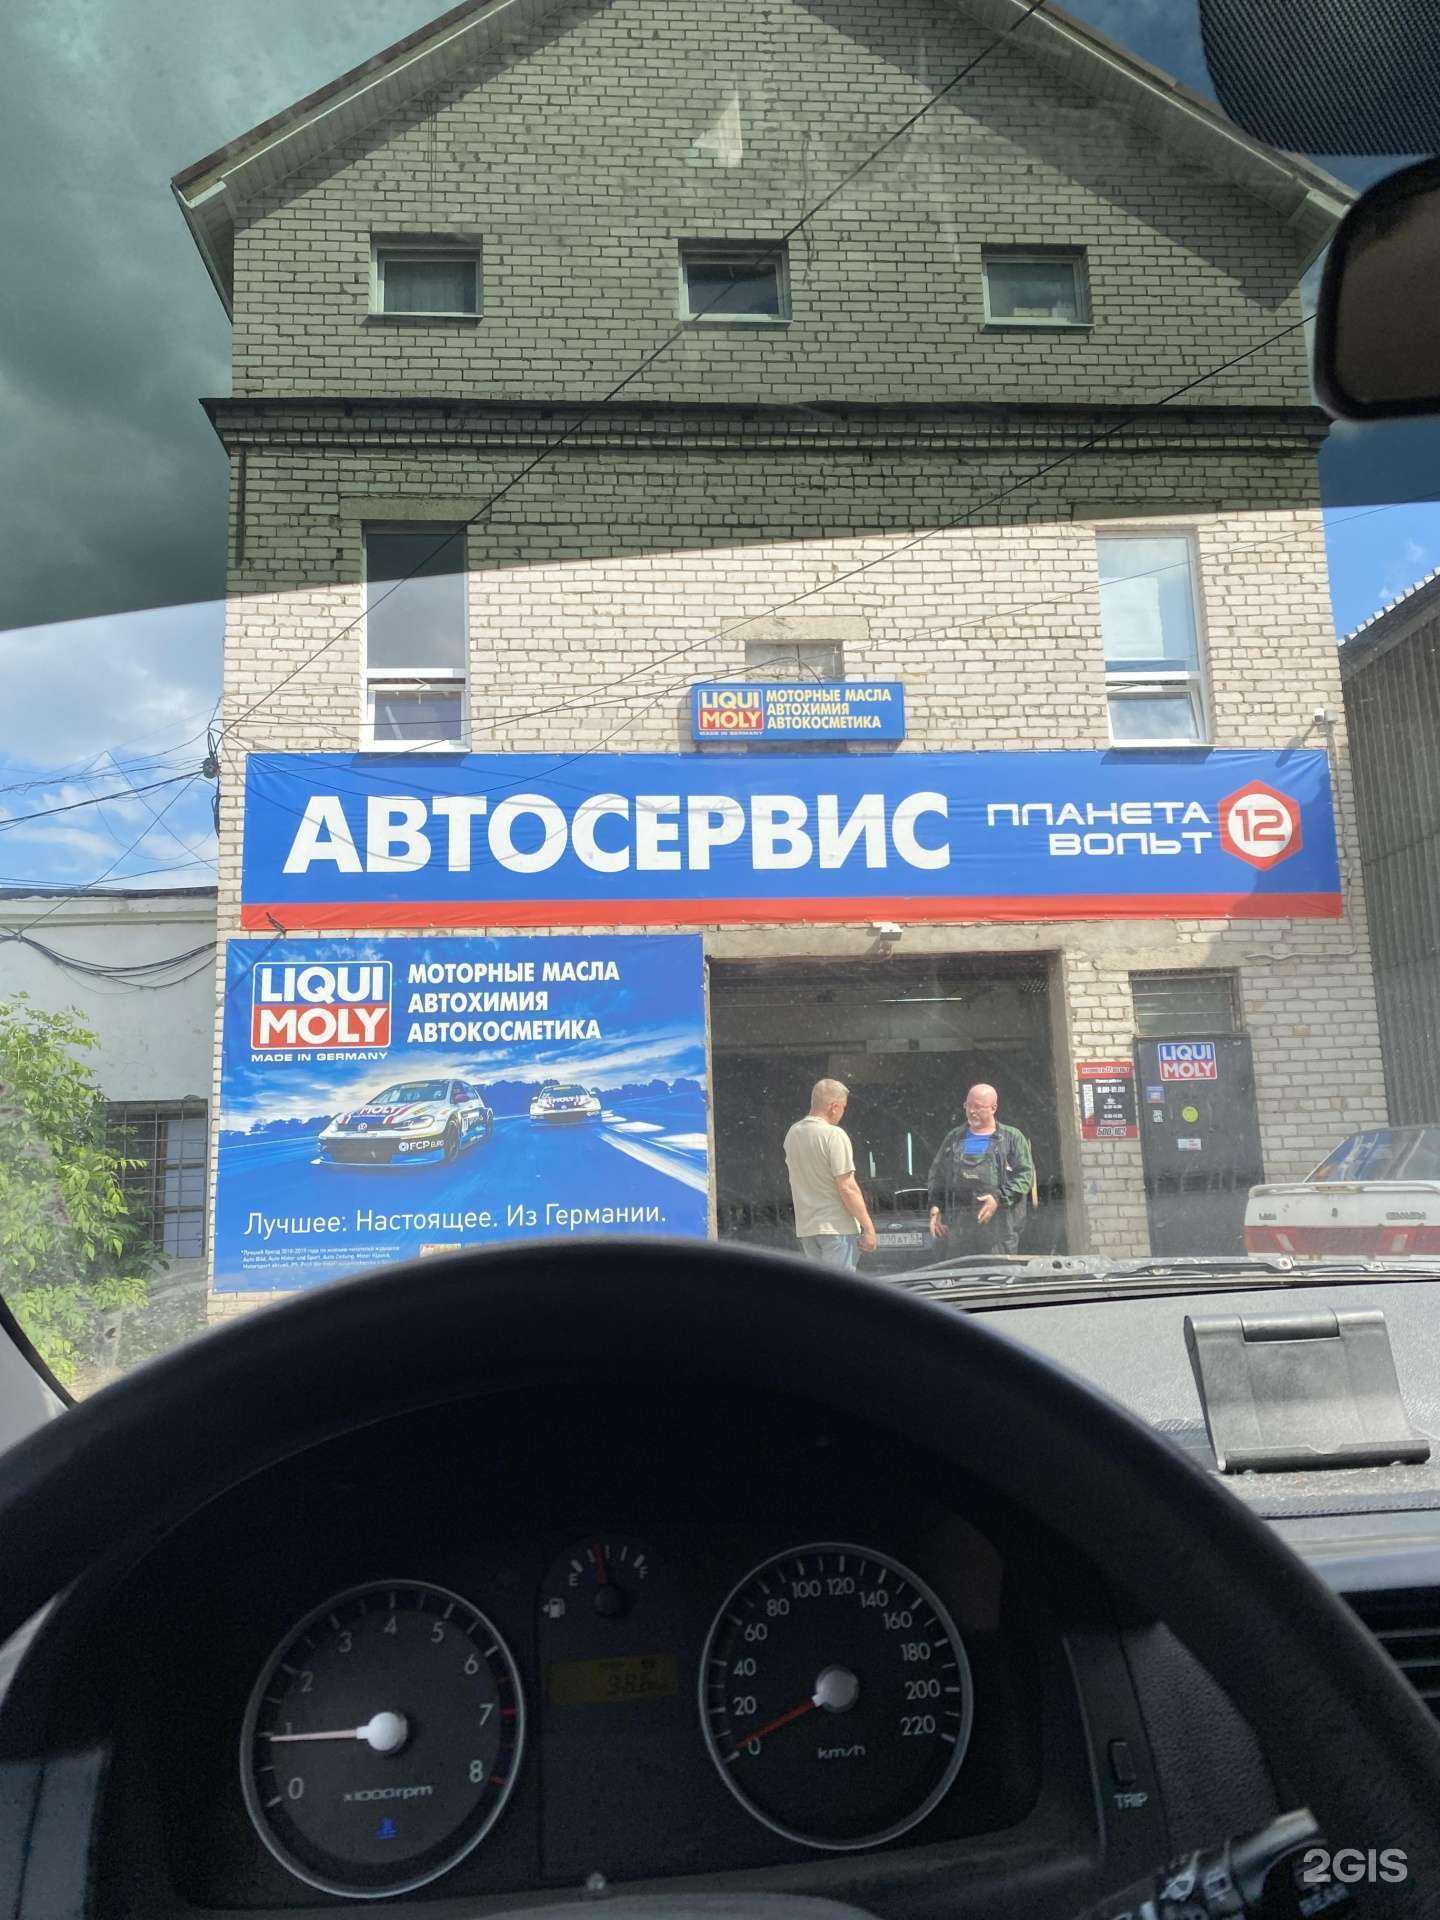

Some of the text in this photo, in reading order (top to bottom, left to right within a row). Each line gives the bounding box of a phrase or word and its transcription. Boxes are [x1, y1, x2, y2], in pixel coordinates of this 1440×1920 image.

[701, 691, 759, 708] LIQUI
[766, 688, 891, 702] МОТОРНЫЕ МАСЛА
[767, 703, 849, 716] АВТОХИМИЯ
[702, 711, 761, 729] MOLY
[767, 716, 882, 729] АВТОКОСМЕТИКА
[987, 801, 1211, 826] ПЛАНЕТА
[282, 791, 951, 873] АВТОСЕРВИС
[1235, 809, 1285, 842] 12
[1049, 832, 1212, 856] ВОЛЬТ
[408, 961, 620, 984] МОТОРНЫЕ МАСЛА
[262, 966, 383, 1004] LIQUI
[408, 992, 548, 1013] АВТОХИМИЯ
[259, 1008, 388, 1044] MOLY
[407, 1019, 602, 1043] АВТОКОСМЕТИКА
[251, 1052, 388, 1062] MADE IN GERMANY
[1161, 1044, 1212, 1061] LIQUI
[1163, 1061, 1214, 1078] MOLY
[410, 1141, 430, 1150] FCP
[243, 1203, 666, 1240] Лучшее: Настоящее. Из Германии.
[569, 1573, 579, 1586] E
[826, 1577, 855, 1595] 120
[792, 1580, 821, 1599] 100
[859, 1590, 889, 1608] 140
[766, 1598, 790, 1616] 80
[384, 1616, 397, 1635] 4
[883, 1611, 913, 1630] 160
[338, 1632, 352, 1652] 3
[431, 1622, 444, 1643] 5
[744, 1623, 768, 1642] 60
[901, 1643, 931, 1662] 180
[464, 1654, 478, 1675] 6
[734, 1658, 756, 1677] 40
[301, 1671, 314, 1692] 2
[905, 1680, 941, 1700] 200
[480, 1703, 494, 1726] 7
[733, 1696, 757, 1716] 20
[901, 1716, 936, 1736] 220
[748, 1738, 761, 1755] 0
[469, 1760, 483, 1783] 8
[288, 1777, 304, 1800] 0
[1114, 1793, 1148, 1809] TRIP
